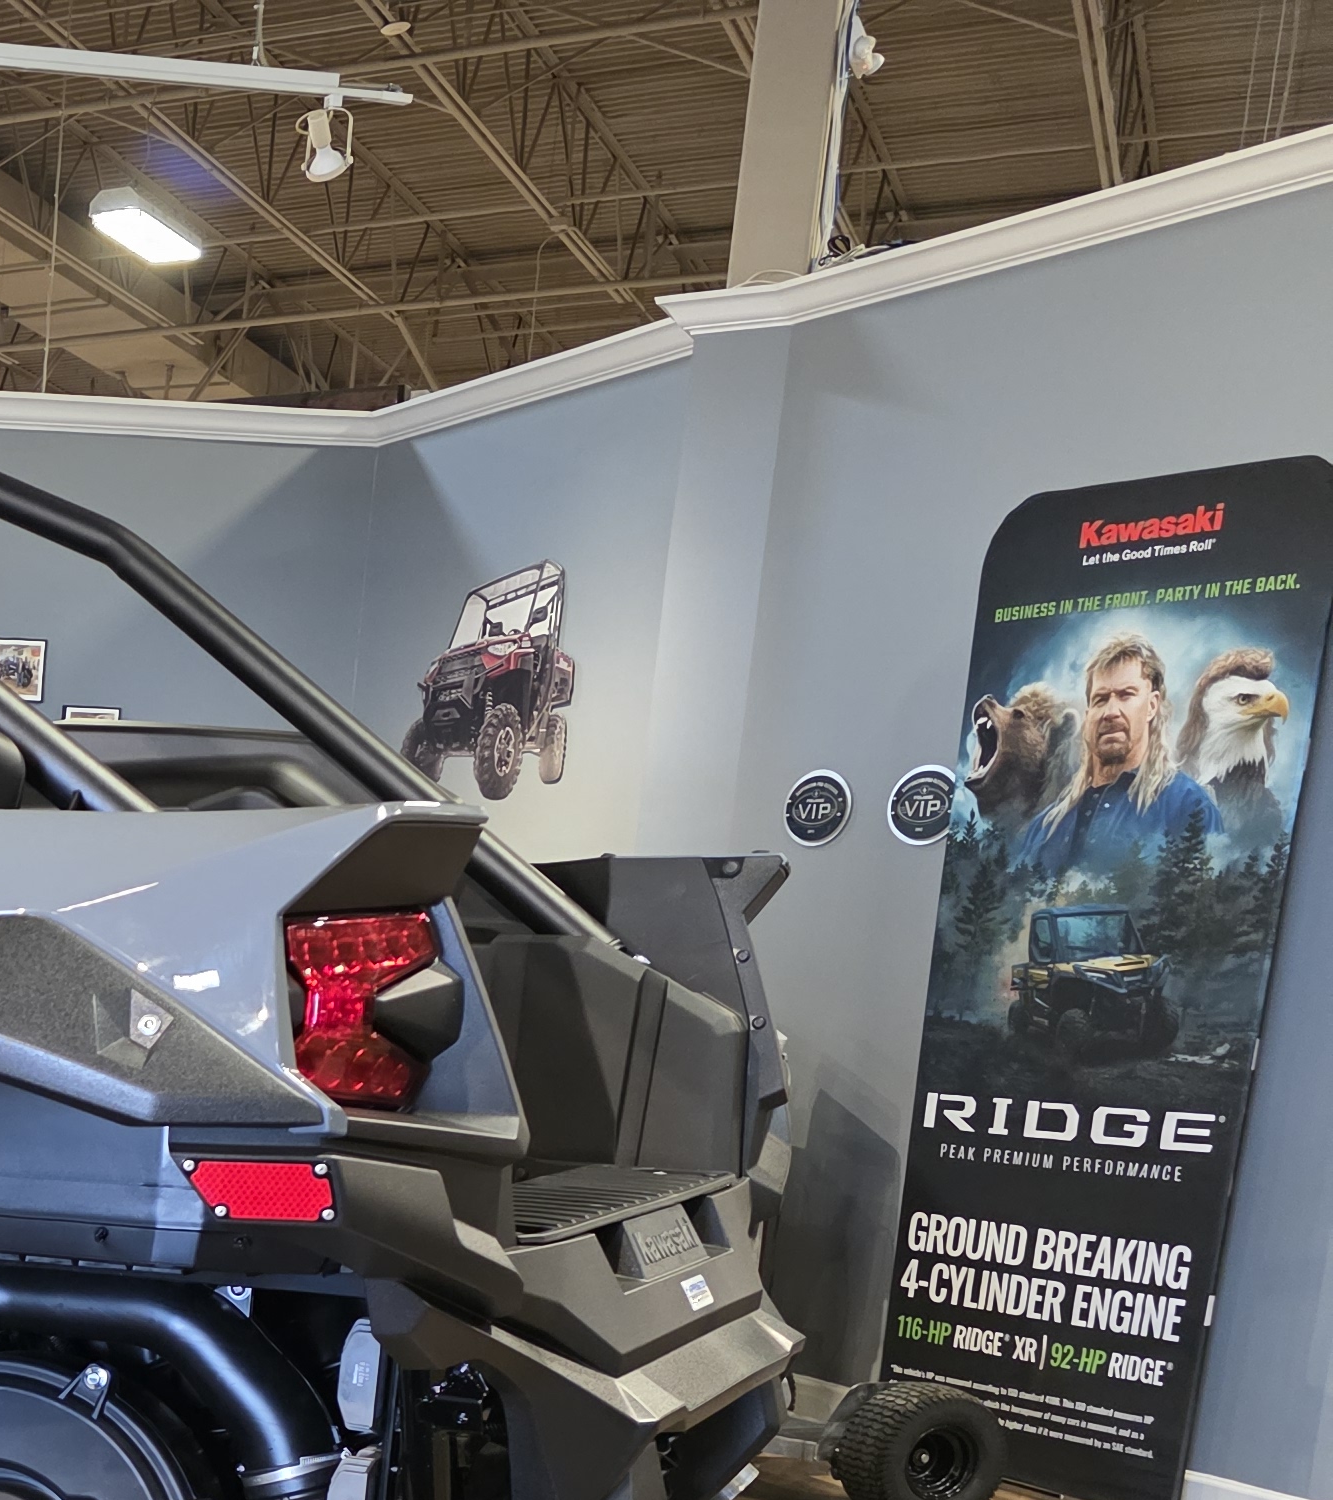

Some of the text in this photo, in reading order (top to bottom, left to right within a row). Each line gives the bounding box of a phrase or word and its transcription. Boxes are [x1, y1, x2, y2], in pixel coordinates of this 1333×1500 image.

[1079, 503, 1226, 548] Kawasaki
[1082, 554, 1101, 566] Let
[1102, 551, 1120, 564] the
[1121, 547, 1152, 561] Good
[1153, 543, 1188, 557] Times
[994, 573, 1301, 623] BUSINESS IN THE FRONT. PARTY IN THE BACK.
[798, 803, 832, 820] VIP
[904, 800, 941, 818] VIP
[922, 1091, 1216, 1153] RIDGE
[939, 1143, 1183, 1182] PEAK PREMIUM PERFORMANCE
[631, 1216, 700, 1266] Kawasaki
[907, 1211, 1193, 1291] GROUND BREAKING
[900, 1258, 1187, 1343] 4-CYLINDER ENGINE
[897, 1315, 952, 1346] 116-HP
[1012, 1337, 1038, 1363] XR
[1050, 1342, 1107, 1375] 92-HP
